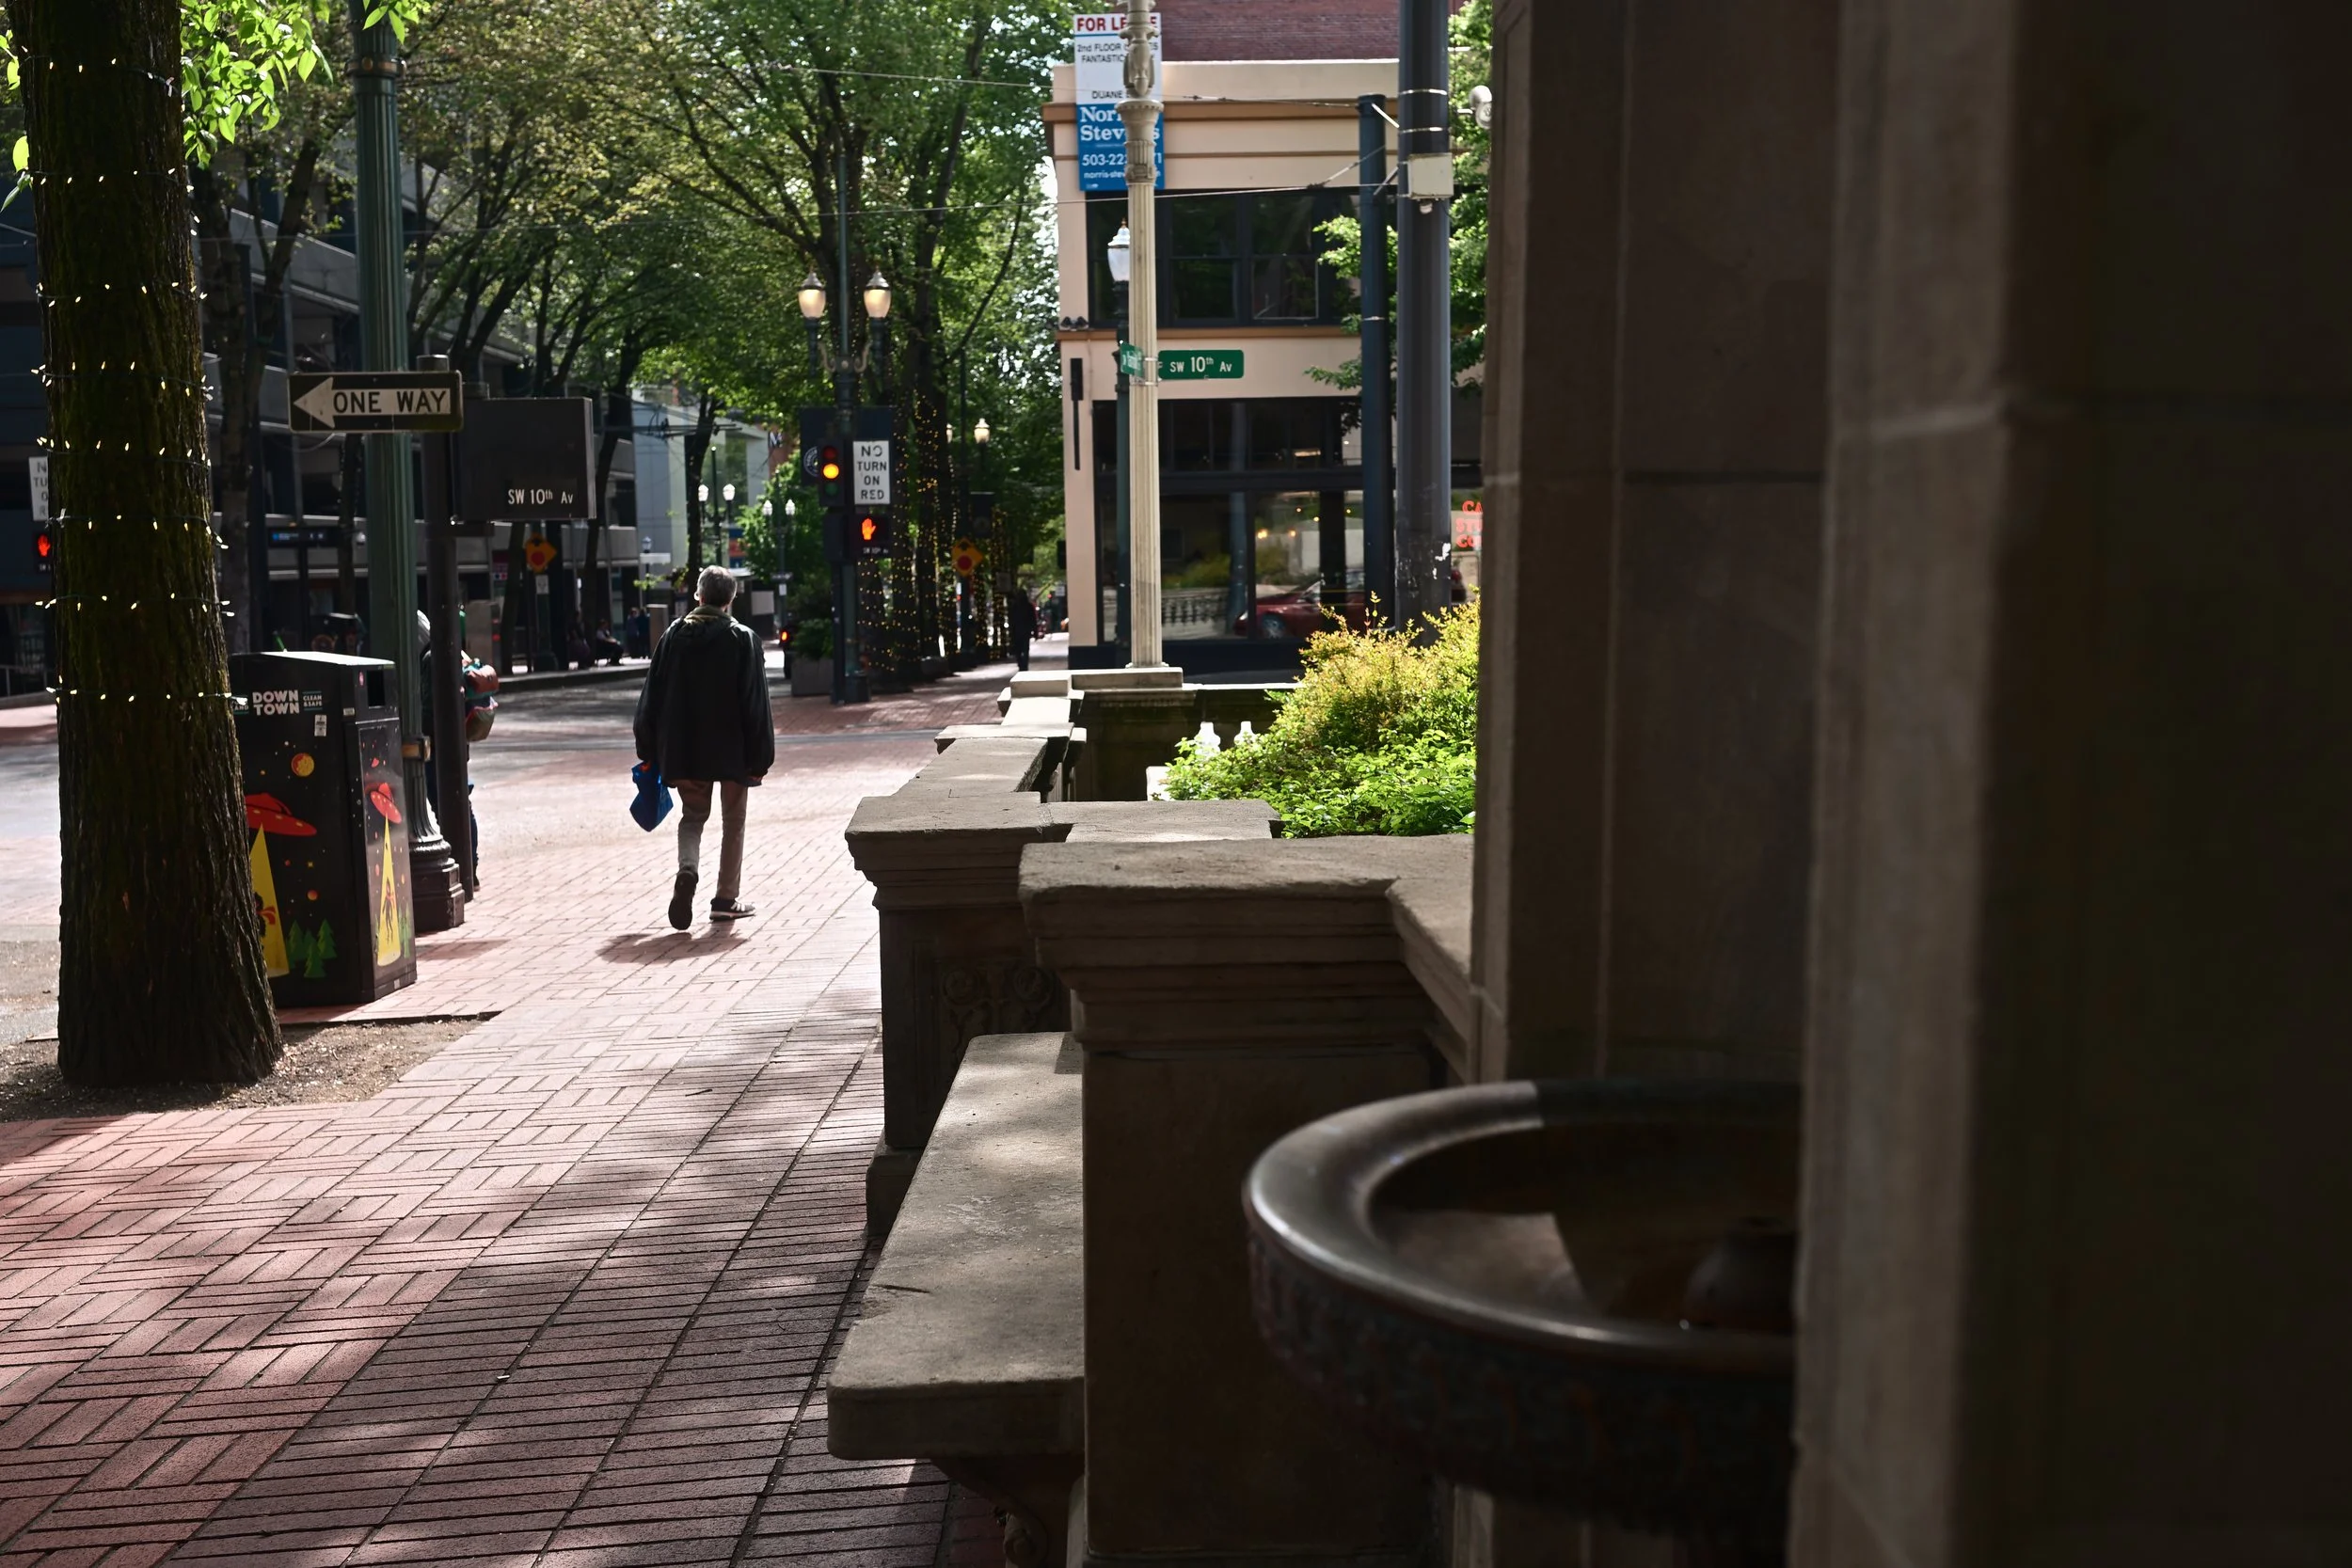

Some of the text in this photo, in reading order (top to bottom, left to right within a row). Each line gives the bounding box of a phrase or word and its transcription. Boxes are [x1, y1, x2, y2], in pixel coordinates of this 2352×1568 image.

[1076, 16, 1157, 31] FOR LEE
[1094, 43, 1121, 52] FLOOR
[1091, 90, 1122, 99] DUANE
[1080, 125, 1160, 141] Stevs
[1082, 152, 1162, 166] 503-22-1
[1169, 356, 1232, 372] SW 10th Av
[333, 388, 447, 414] ONE WAY
[861, 445, 882, 457] NO
[37, 462, 47, 473] N
[857, 461, 887, 471] TURN
[33, 477, 48, 487] TU
[864, 476, 880, 485] ON
[507, 488, 573, 505] SW 10th Av
[861, 489, 884, 499] RED
[252, 689, 299, 704] DOWN
[253, 702, 300, 716] TOWN
